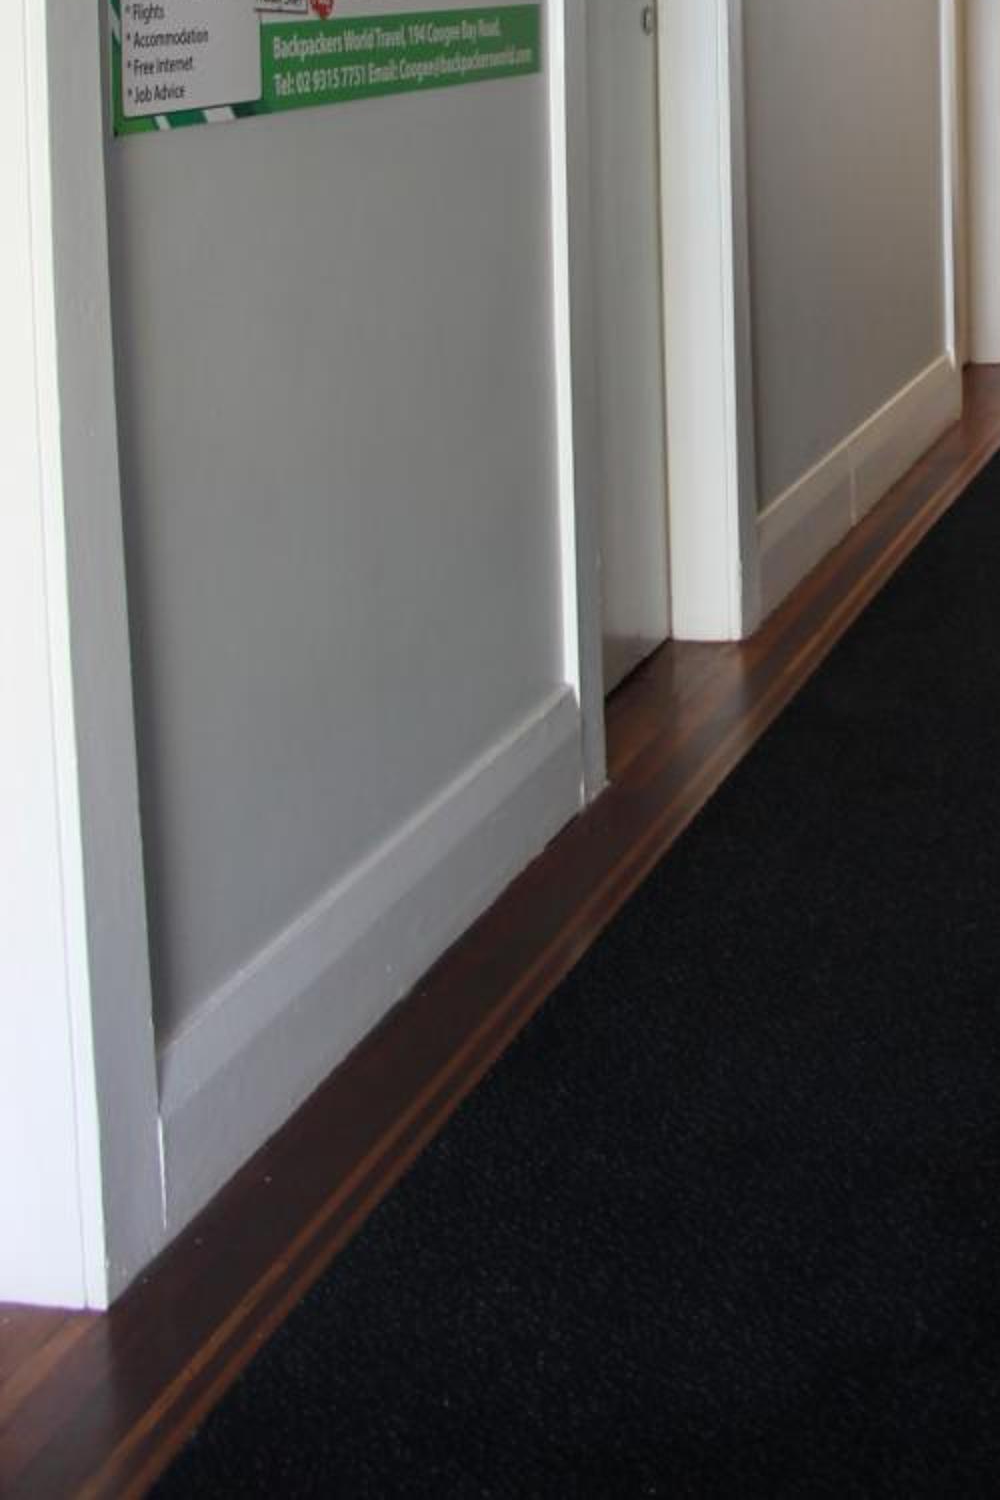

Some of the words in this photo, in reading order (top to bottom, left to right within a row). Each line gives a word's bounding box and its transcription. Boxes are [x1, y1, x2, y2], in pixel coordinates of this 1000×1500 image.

[132, 2, 165, 24] Flights
[133, 28, 209, 49] Accommodation
[273, 31, 342, 63] Backpackers
[343, 27, 374, 52] World
[408, 22, 427, 45] 194
[428, 20, 461, 47] Coogee
[133, 58, 155, 76] Free
[274, 71, 295, 96] Tel:
[295, 71, 311, 94] 02
[312, 67, 339, 92] 9315
[135, 85, 152, 104] Job
[153, 84, 185, 101] Advice
